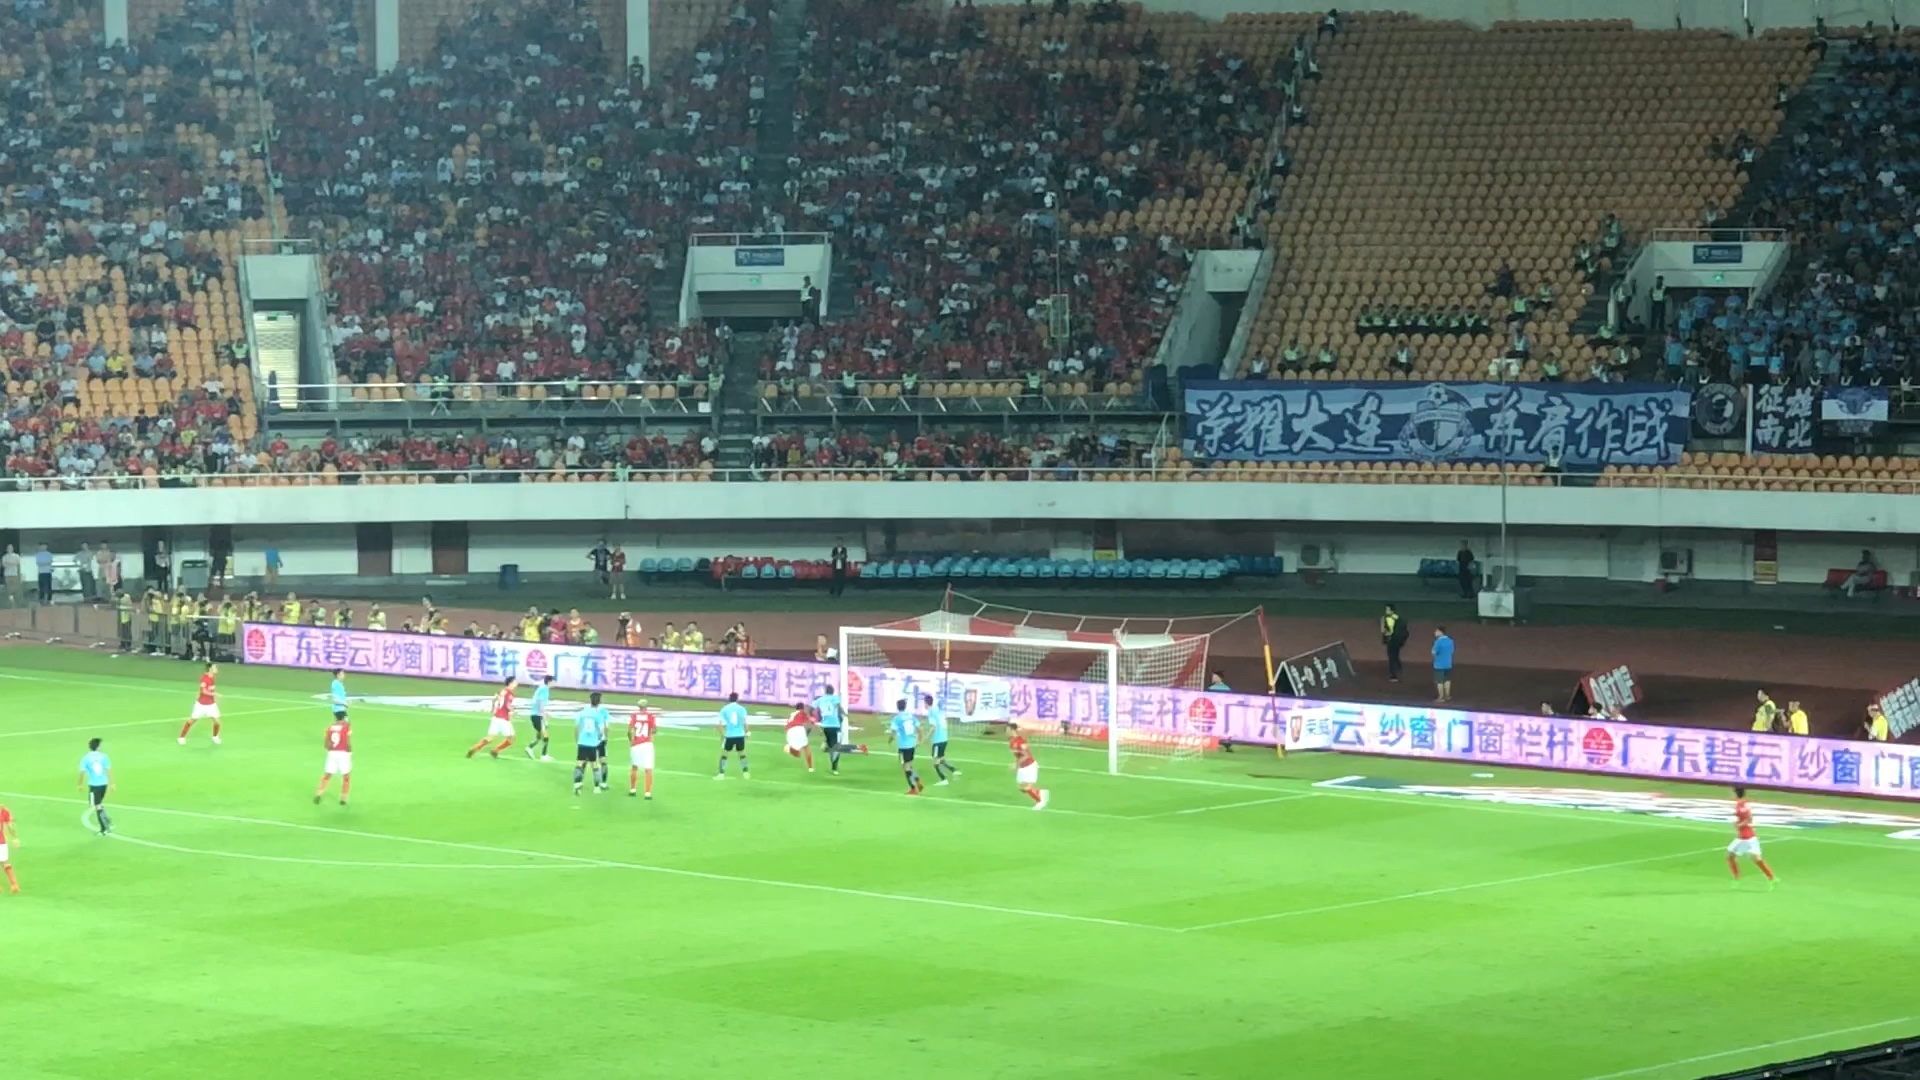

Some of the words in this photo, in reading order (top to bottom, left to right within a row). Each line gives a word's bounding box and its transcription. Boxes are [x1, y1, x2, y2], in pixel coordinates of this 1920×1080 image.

[1196, 391, 1394, 456] 荣耀大连
[1484, 388, 1673, 461] 并肩作战
[635, 722, 649, 738] 24
[330, 731, 341, 749] 9
